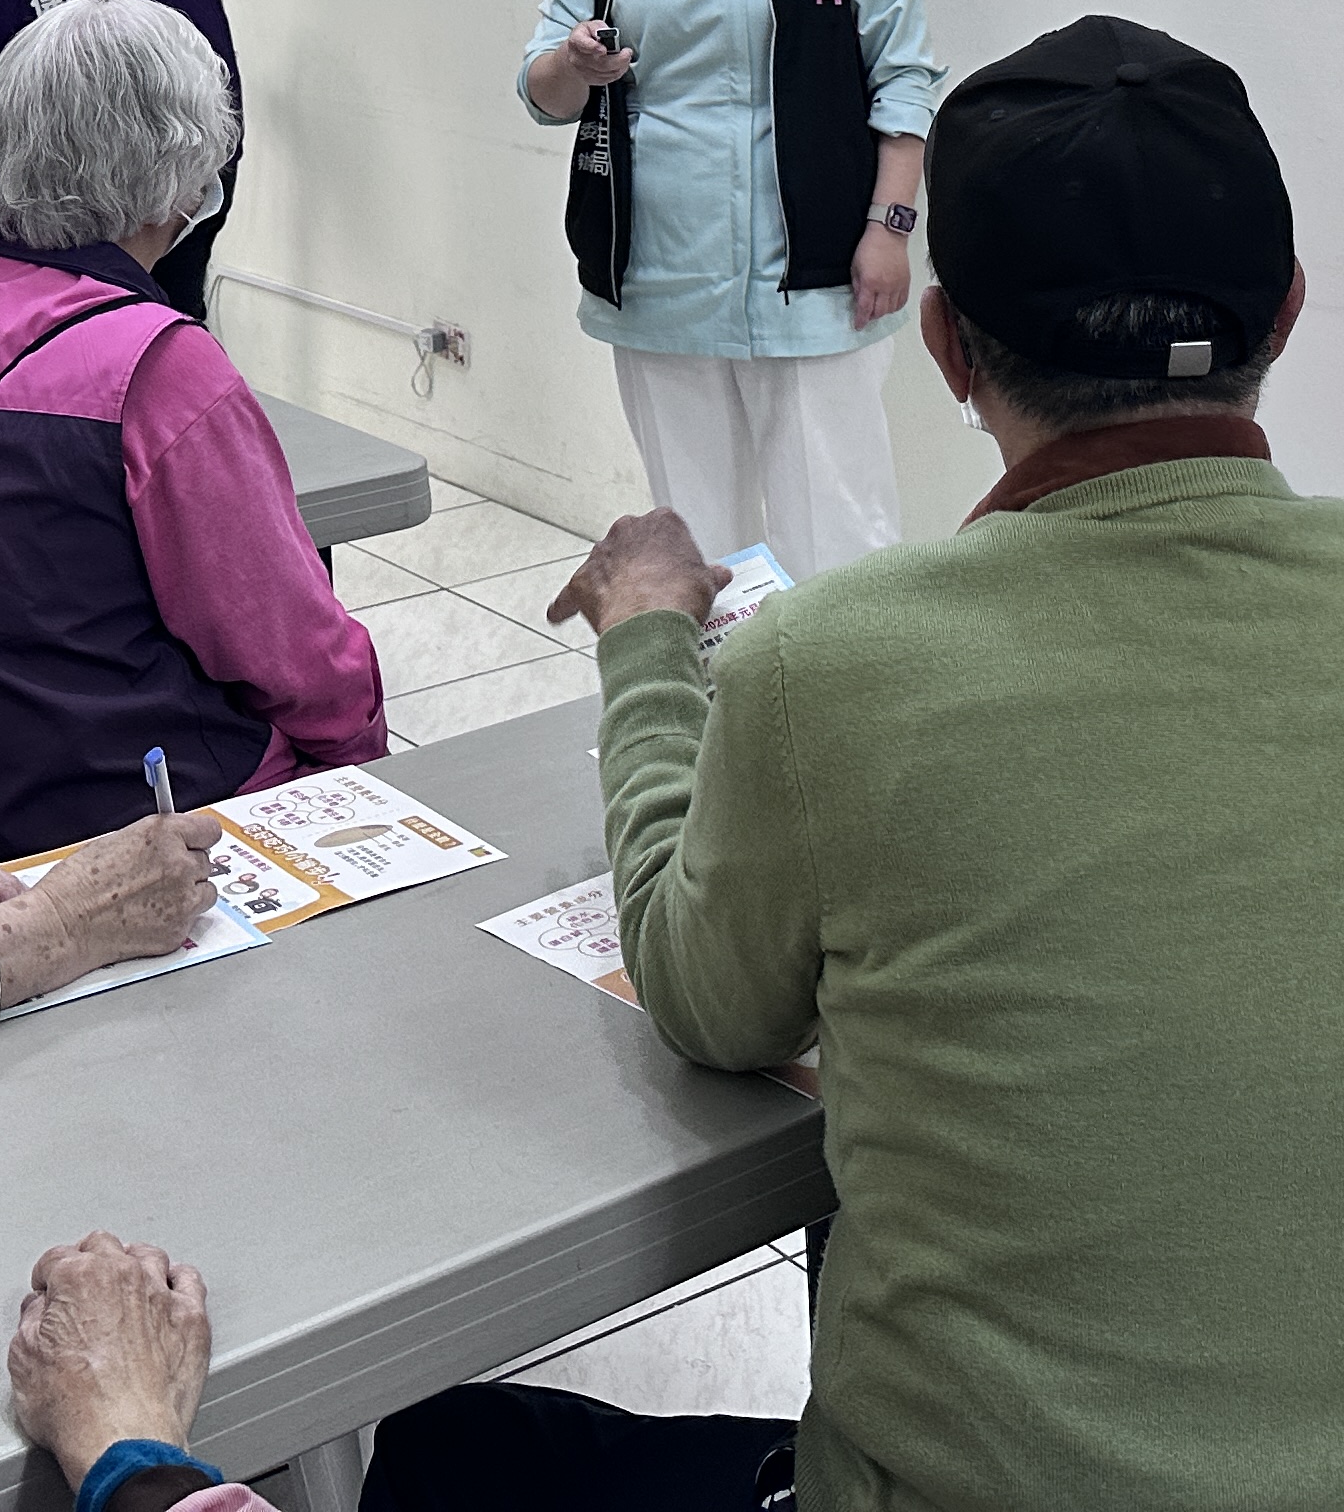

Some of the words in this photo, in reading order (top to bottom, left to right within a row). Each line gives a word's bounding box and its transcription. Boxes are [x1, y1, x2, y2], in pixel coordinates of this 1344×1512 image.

[513, 890, 604, 928] 主要營養成分
